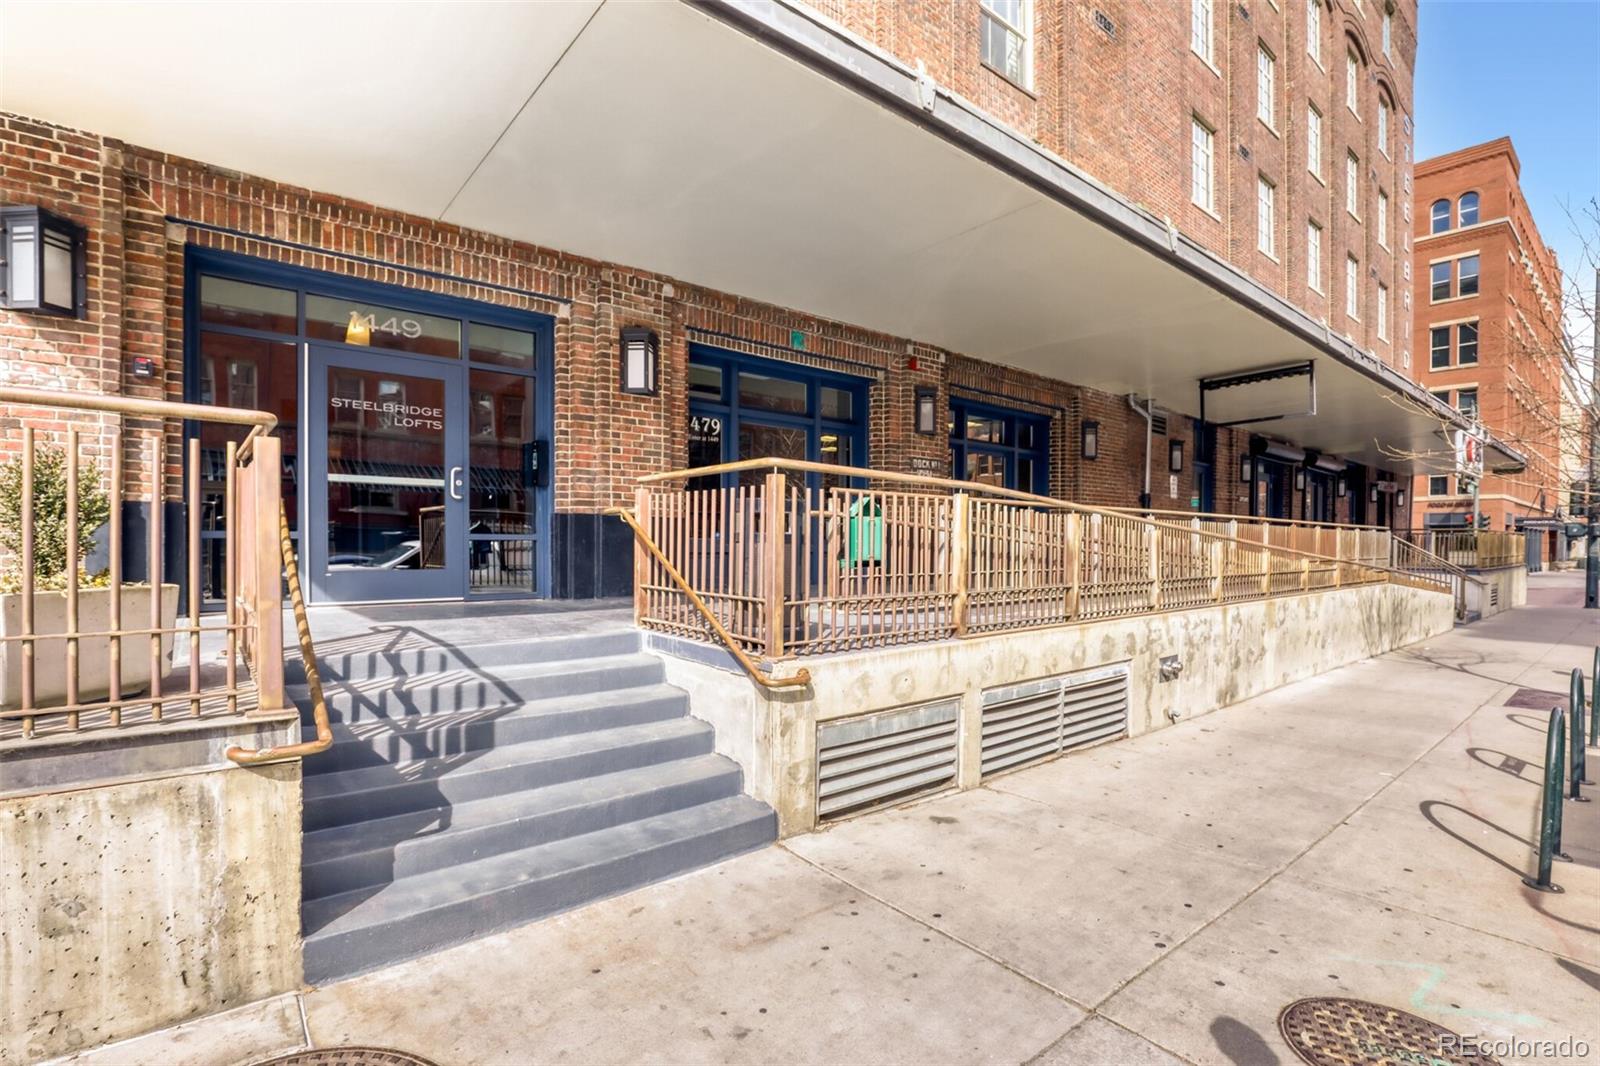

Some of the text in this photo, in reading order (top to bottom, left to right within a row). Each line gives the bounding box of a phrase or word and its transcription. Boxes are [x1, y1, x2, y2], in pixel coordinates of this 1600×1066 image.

[350, 311, 422, 339] 1449
[331, 397, 443, 418] STEELBRIDGE
[394, 417, 443, 430] LOFTS
